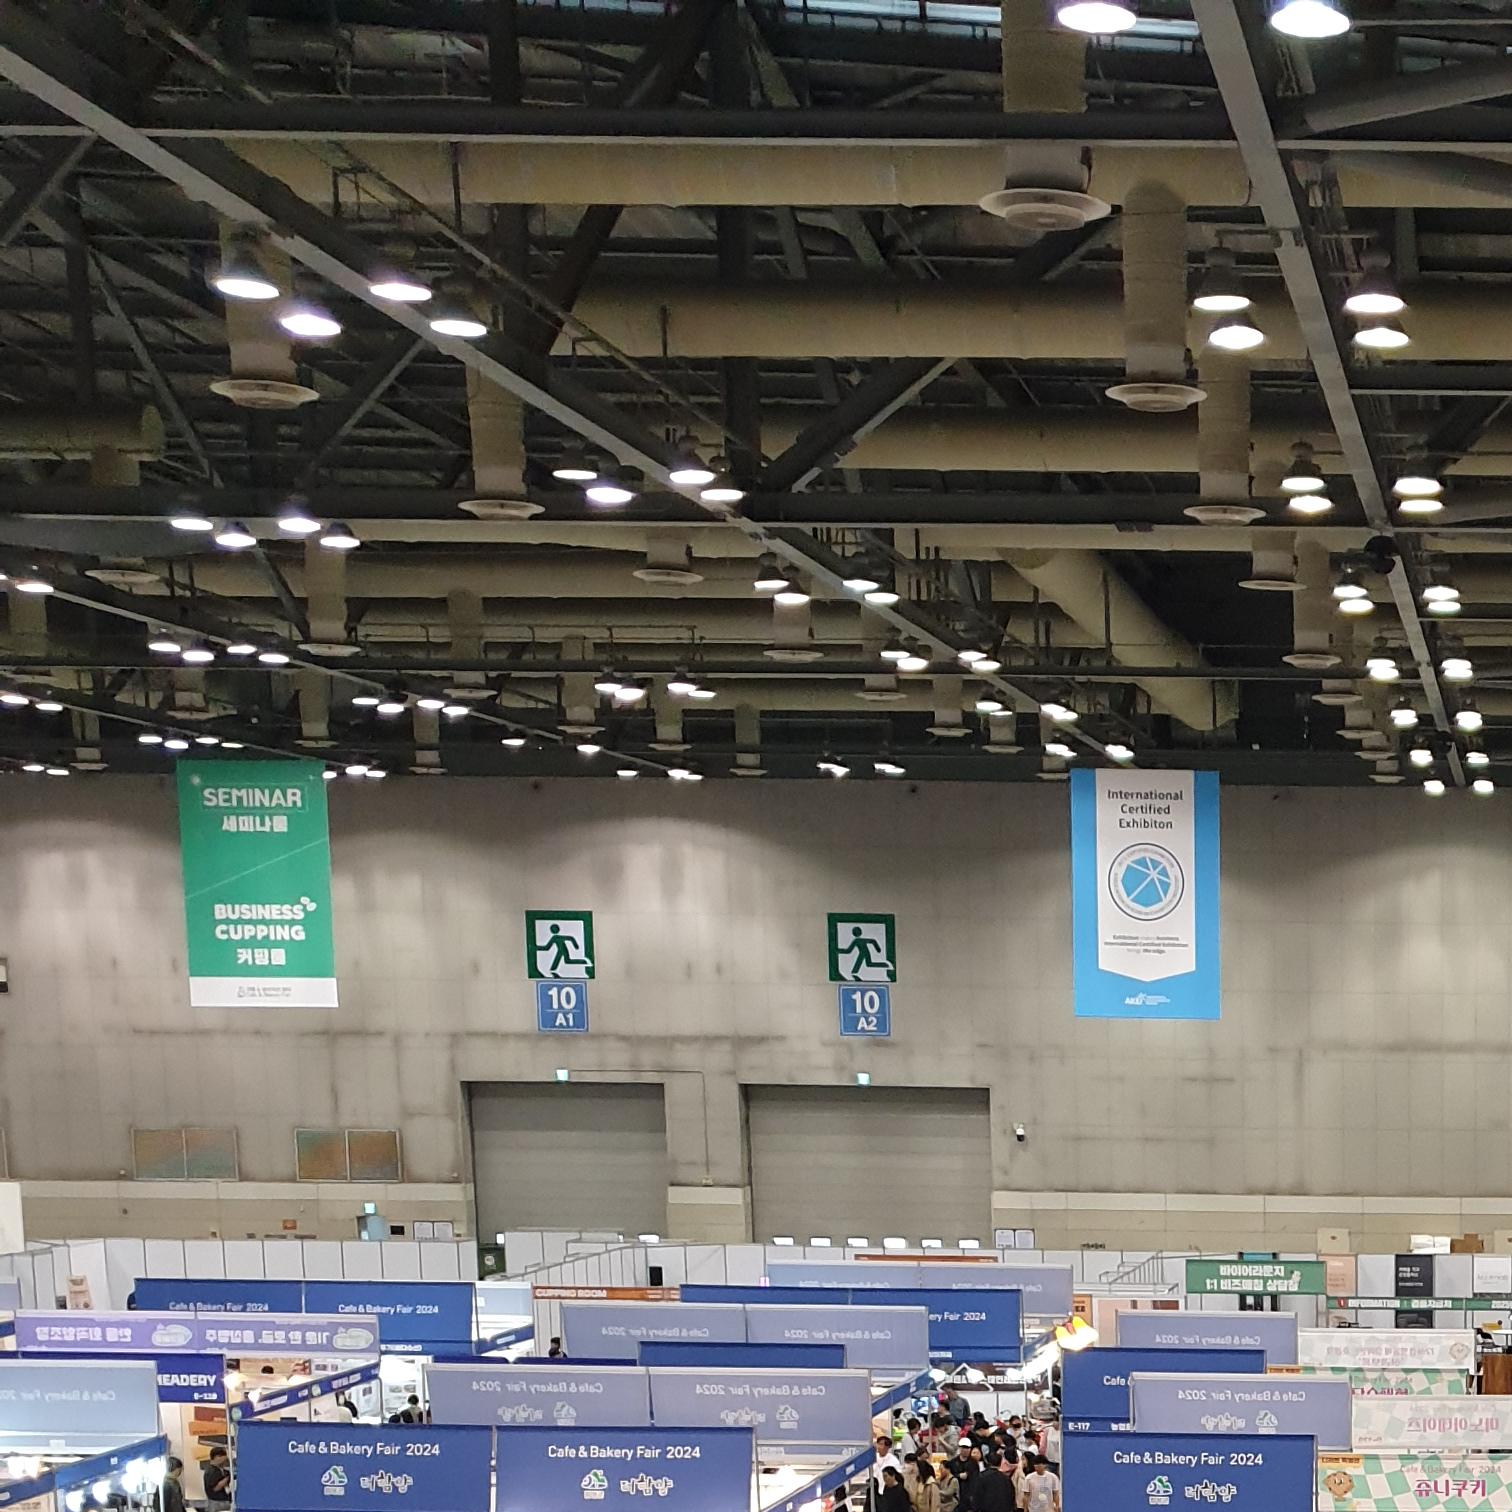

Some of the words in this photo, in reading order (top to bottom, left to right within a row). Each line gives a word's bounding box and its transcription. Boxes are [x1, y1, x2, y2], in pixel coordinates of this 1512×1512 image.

[203, 788, 302, 808] SEMINAR
[1107, 789, 1183, 801] International
[1120, 804, 1171, 815] Certified
[222, 816, 288, 832] 세미나룸
[1118, 818, 1173, 830] Exhibiton
[214, 904, 304, 920] BUSINESS
[215, 925, 306, 941] CUPPING
[236, 948, 286, 965] 커핑룸
[547, 987, 576, 1010] 10
[852, 990, 880, 1014] 10
[554, 1013, 575, 1027] A1
[857, 1017, 878, 1031] A2
[338, 1303, 357, 1313] Cafe
[357, 1303, 365, 1313] &
[365, 1303, 395, 1315] Bakery
[396, 1304, 413, 1314] Fair
[415, 1304, 439, 1314] 2024
[944, 1312, 960, 1322] Fair
[963, 1312, 986, 1322] 2024
[288, 1441, 317, 1454] Cafe
[318, 1441, 328, 1455] &
[330, 1442, 374, 1458] Bakery
[376, 1442, 402, 1456] Fair
[406, 1443, 440, 1456] 2024
[547, 1445, 576, 1459] Cafe
[578, 1445, 588, 1459] &
[589, 1445, 634, 1462] Bakery
[636, 1446, 662, 1459] Fair
[666, 1446, 701, 1460] 2024
[1113, 1451, 1141, 1465] Cafe
[1142, 1451, 1153, 1465] &
[1154, 1452, 1198, 1468] Bakery
[1200, 1452, 1225, 1466] Fair
[1229, 1453, 1263, 1466] 2024
